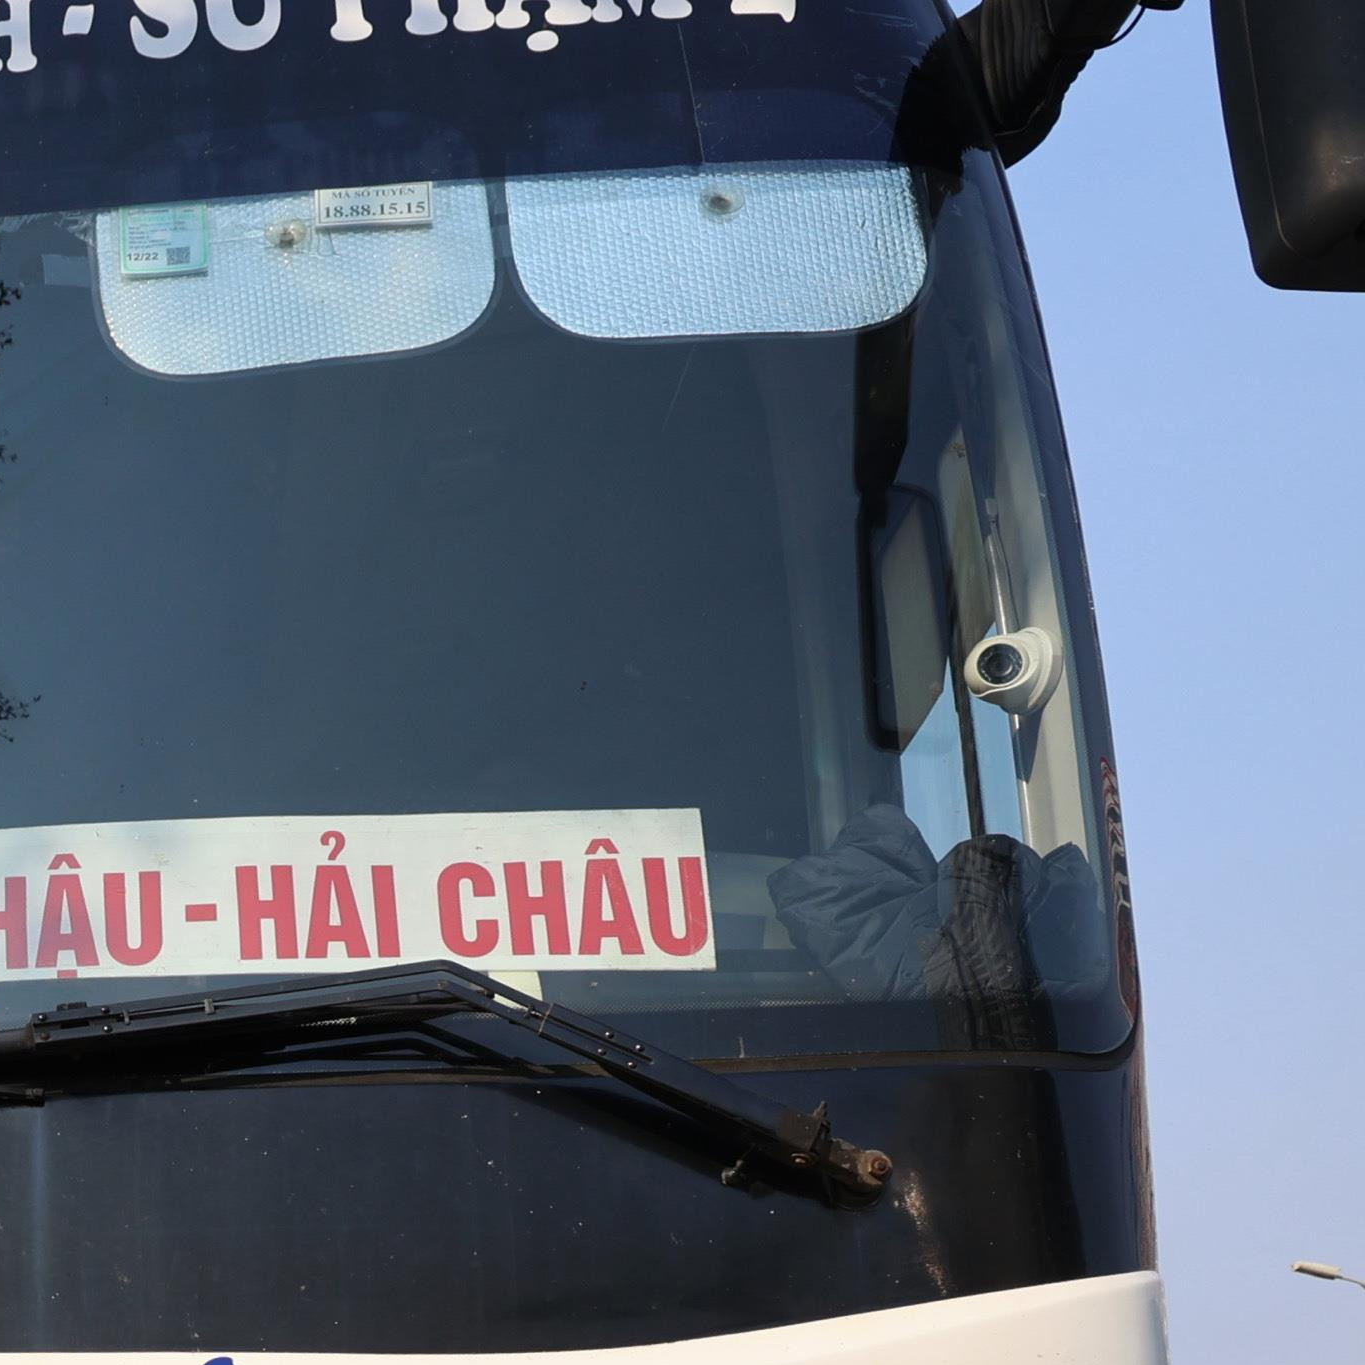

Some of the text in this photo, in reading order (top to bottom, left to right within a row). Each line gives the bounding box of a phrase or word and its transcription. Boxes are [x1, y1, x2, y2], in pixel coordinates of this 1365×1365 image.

[325, 201, 426, 219] 18.88.15.15
[127, 252, 159, 262] 12/22
[437, 838, 709, 958] CHÂU
